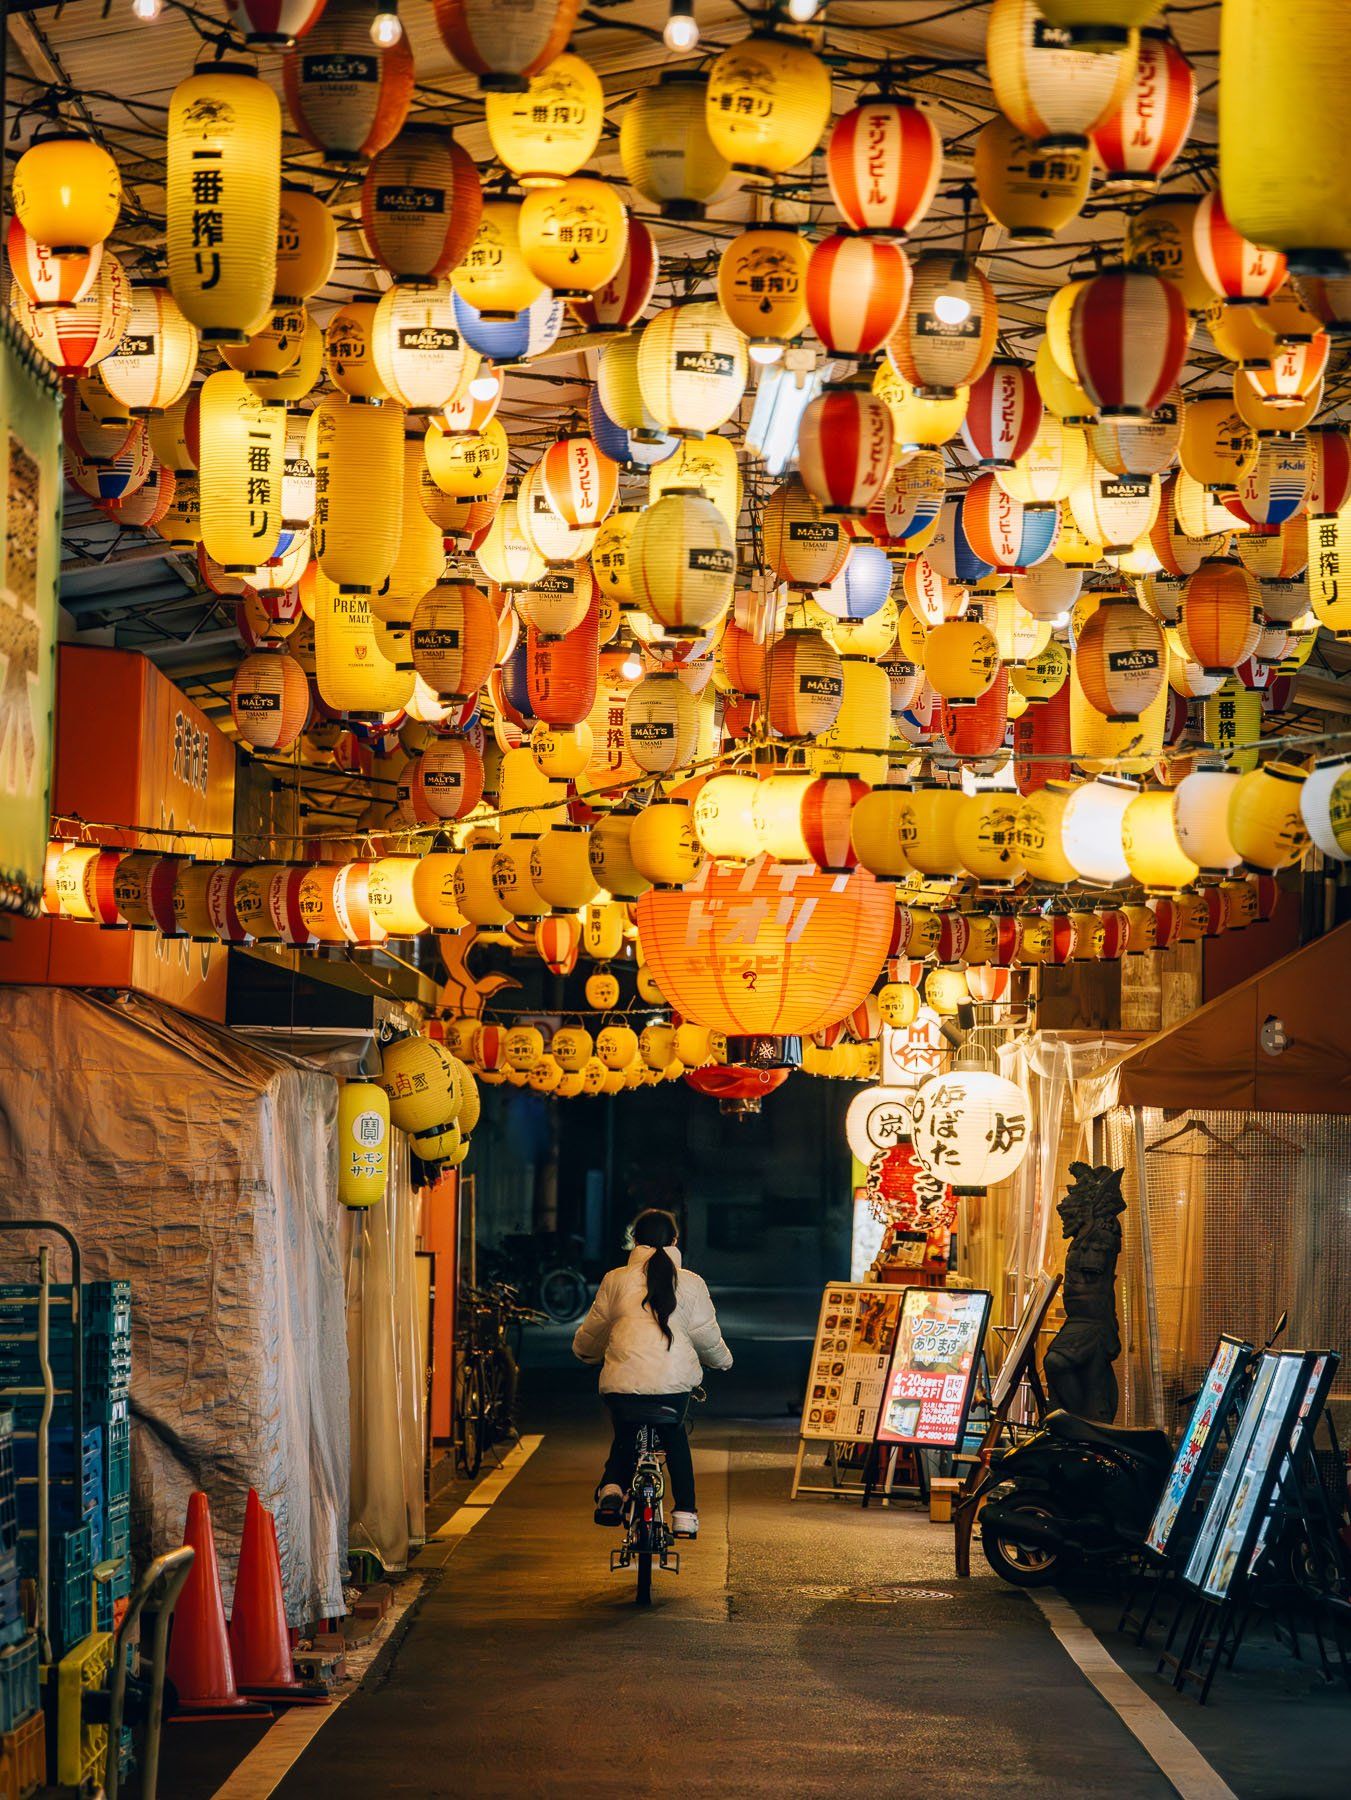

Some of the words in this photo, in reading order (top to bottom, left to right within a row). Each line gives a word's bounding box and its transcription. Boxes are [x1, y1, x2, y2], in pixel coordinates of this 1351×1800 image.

[311, 62, 367, 74] MALT'S
[710, 93, 773, 117] 一番搾り
[513, 106, 585, 123] 一番搾り
[868, 115, 890, 204] キリンビール
[1006, 160, 1080, 181] 一番搾り
[384, 194, 434, 206] MALT'S
[192, 150, 224, 290] 一番搾り
[542, 226, 608, 243] 一番搾り
[735, 277, 798, 292] 一番搾り
[104, 262, 122, 339] アサヒビール
[117, 340, 147, 352] ALT'S
[404, 333, 454, 347] MALT'S
[684, 357, 730, 369] MALT'S
[999, 375, 1016, 442] キリンビール
[864, 405, 883, 485] キリンビール
[450, 448, 499, 463] 一番搾り
[248, 431, 272, 538] 一番搾り
[576, 448, 592, 509] キリンビール
[1107, 485, 1146, 494] MALT'S
[797, 527, 834, 536] MALT'S
[534, 579, 569, 590] MALT'S
[922, 561, 938, 612] キリンビール
[333, 598, 373, 613] PREM
[417, 635, 452, 644] MALT'S
[1117, 656, 1155, 666] MALT'S
[534, 650, 552, 702] 搾り
[1027, 664, 1063, 675] 一番搾り
[807, 681, 840, 692] MALT'S
[241, 699, 274, 707] MALT'S
[607, 697, 627, 771] 一番搾り
[634, 727, 668, 736] MALT'S
[428, 776, 456, 784] MALT'S
[272, 876, 286, 932] キリンビール
[684, 897, 820, 947] ドオリ
[879, 1113, 903, 1137] 炭
[929, 1085, 966, 1165] 炉ばた
[985, 1113, 1025, 1154] 炉
[352, 1152, 383, 1163] レモン
[351, 1165, 383, 1178] サワー
[912, 1318, 971, 1336] ソファー席
[913, 1336, 960, 1353] あります
[946, 1390, 958, 1398] OK
